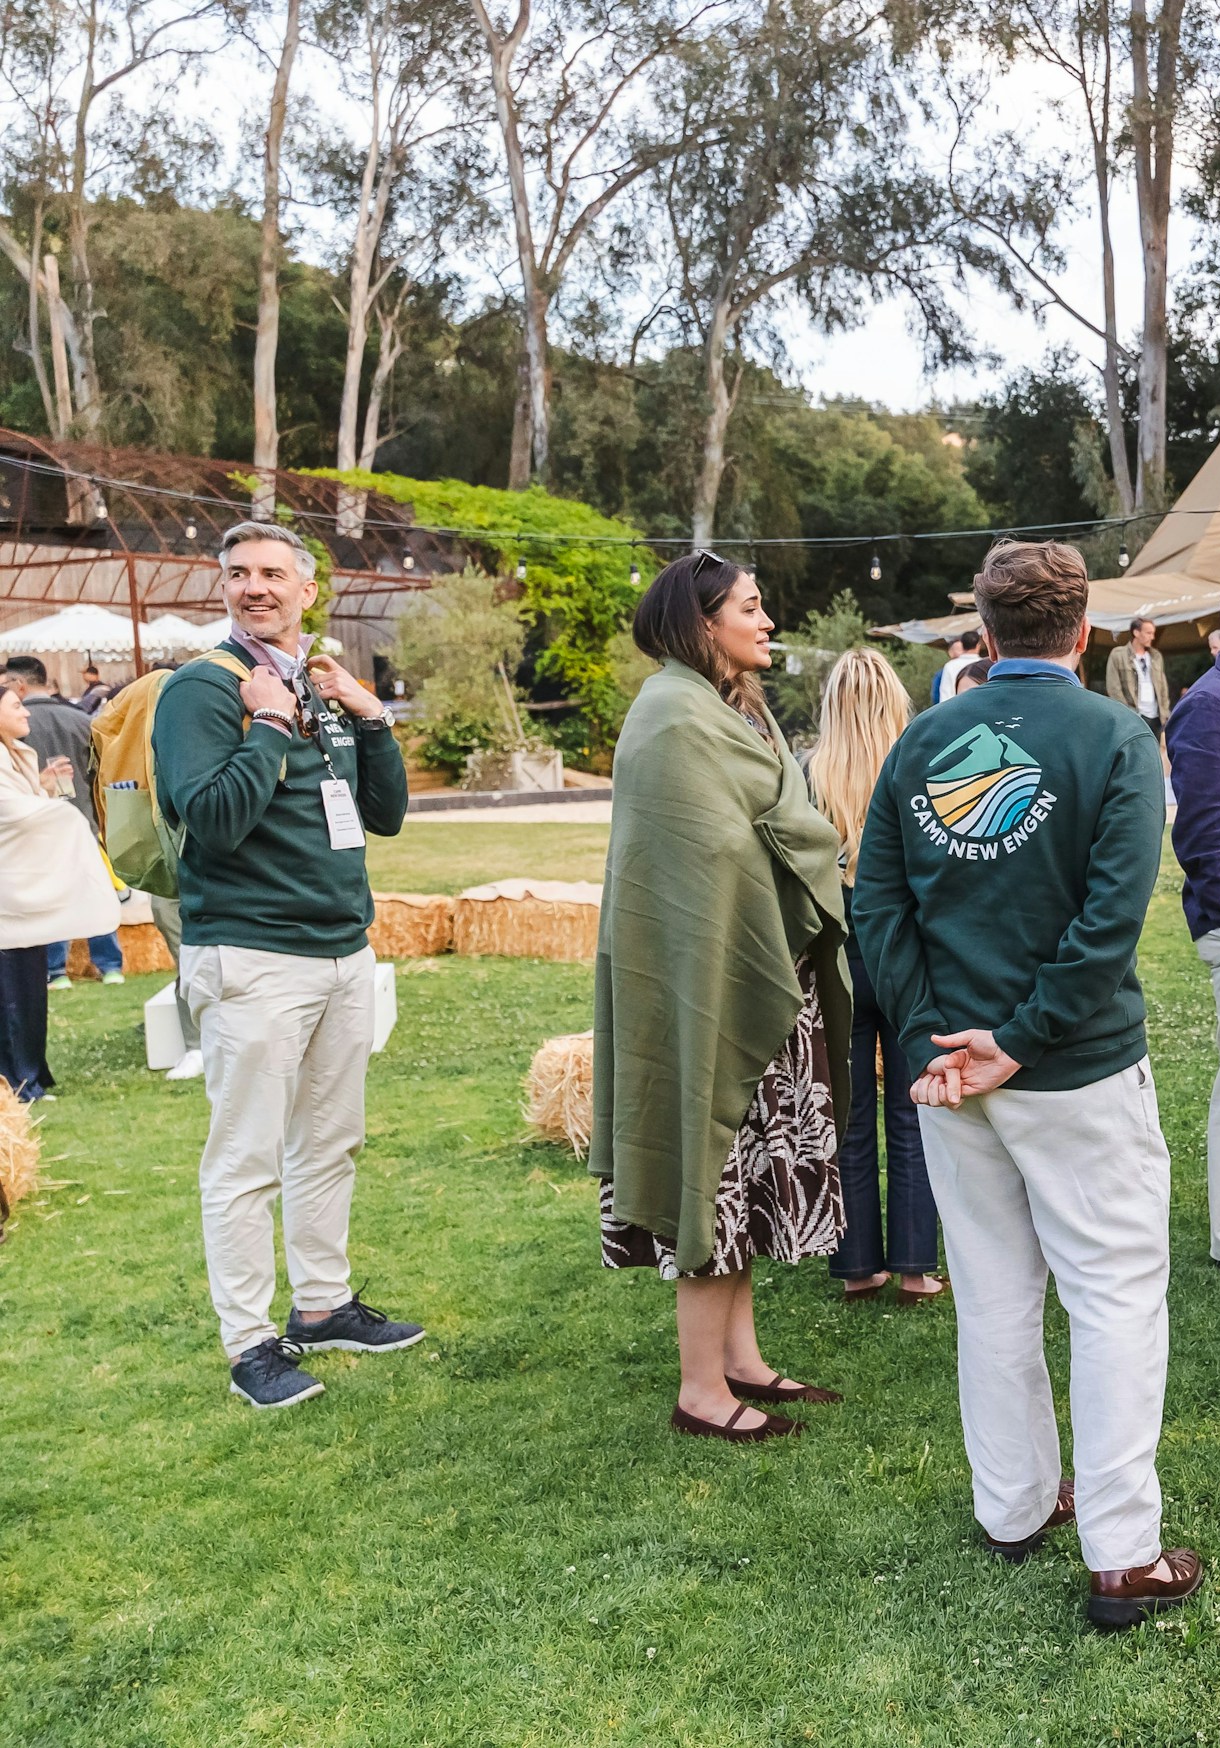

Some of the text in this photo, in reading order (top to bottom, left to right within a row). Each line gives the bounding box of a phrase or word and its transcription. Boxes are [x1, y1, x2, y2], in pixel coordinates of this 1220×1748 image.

[331, 736, 355, 747] ENGEN
[910, 790, 1058, 861] CAMP NEW ENGEN
